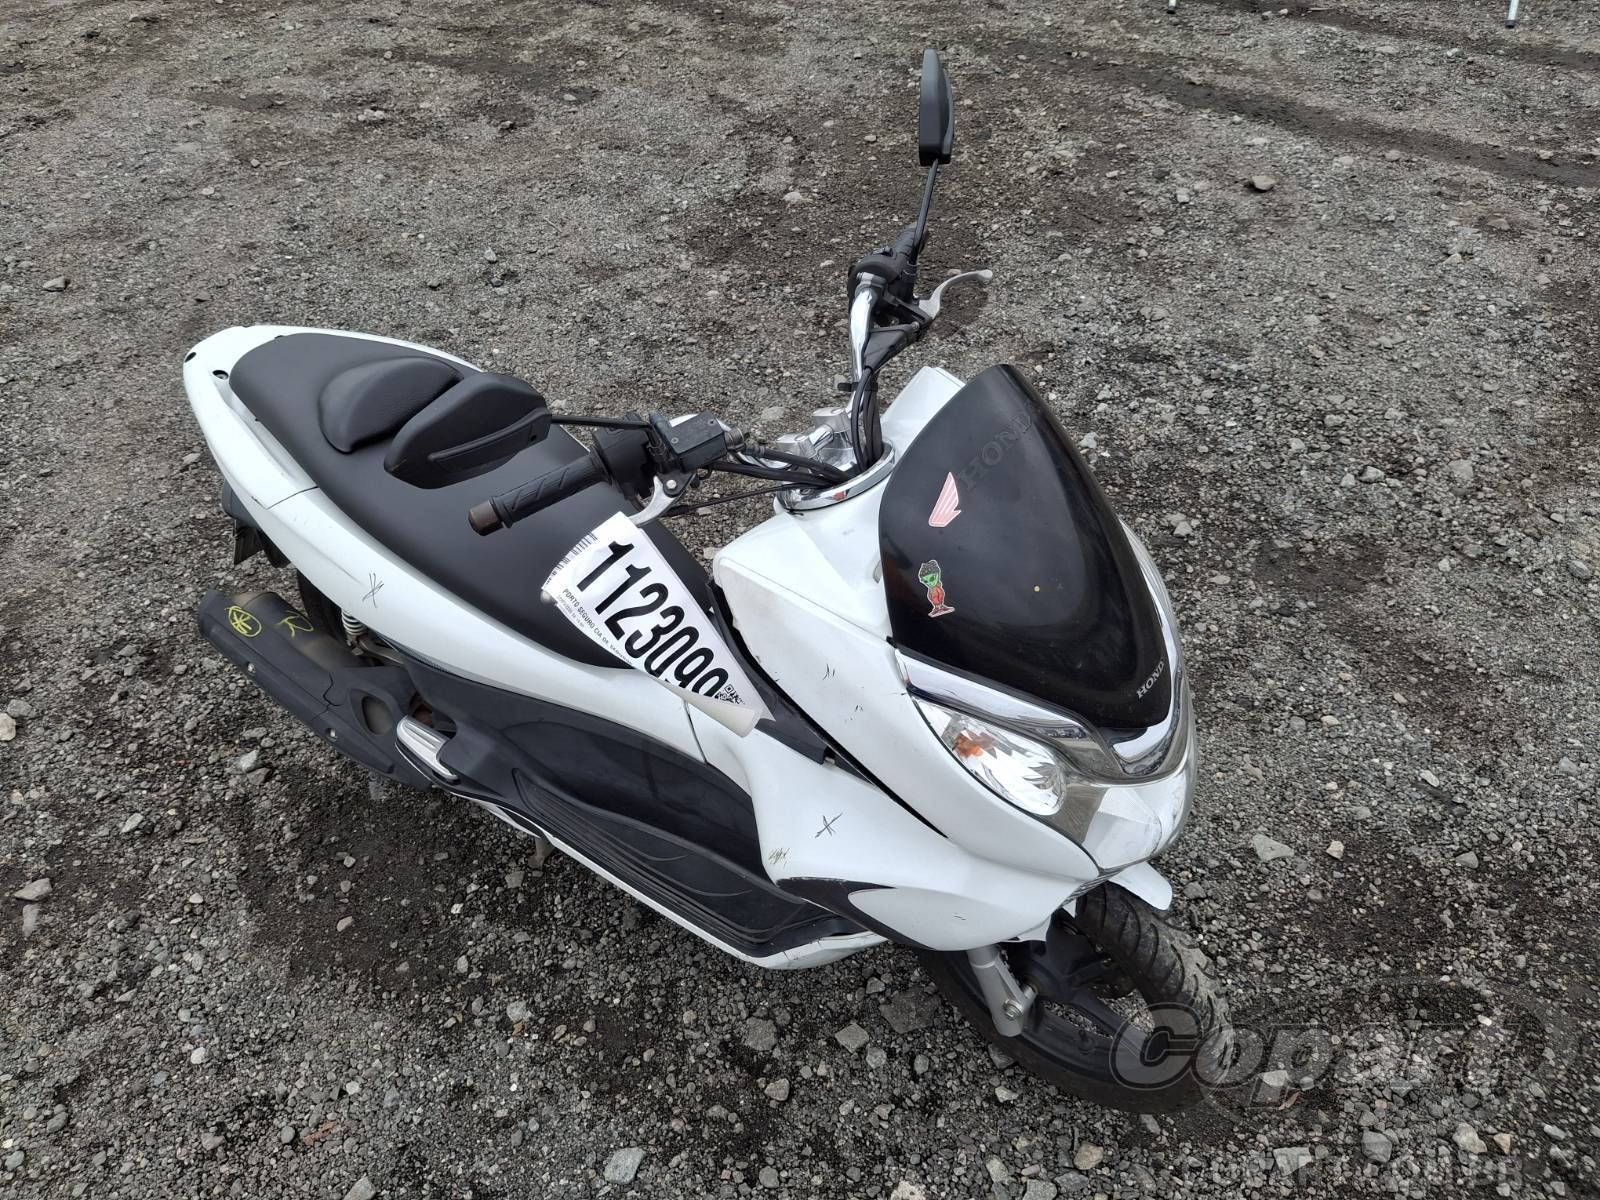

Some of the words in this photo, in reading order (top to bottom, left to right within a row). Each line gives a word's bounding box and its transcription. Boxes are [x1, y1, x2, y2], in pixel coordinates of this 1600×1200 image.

[562, 588, 579, 607] PORTO
[578, 606, 595, 629] SEGURO
[1136, 658, 1166, 700] HOND
